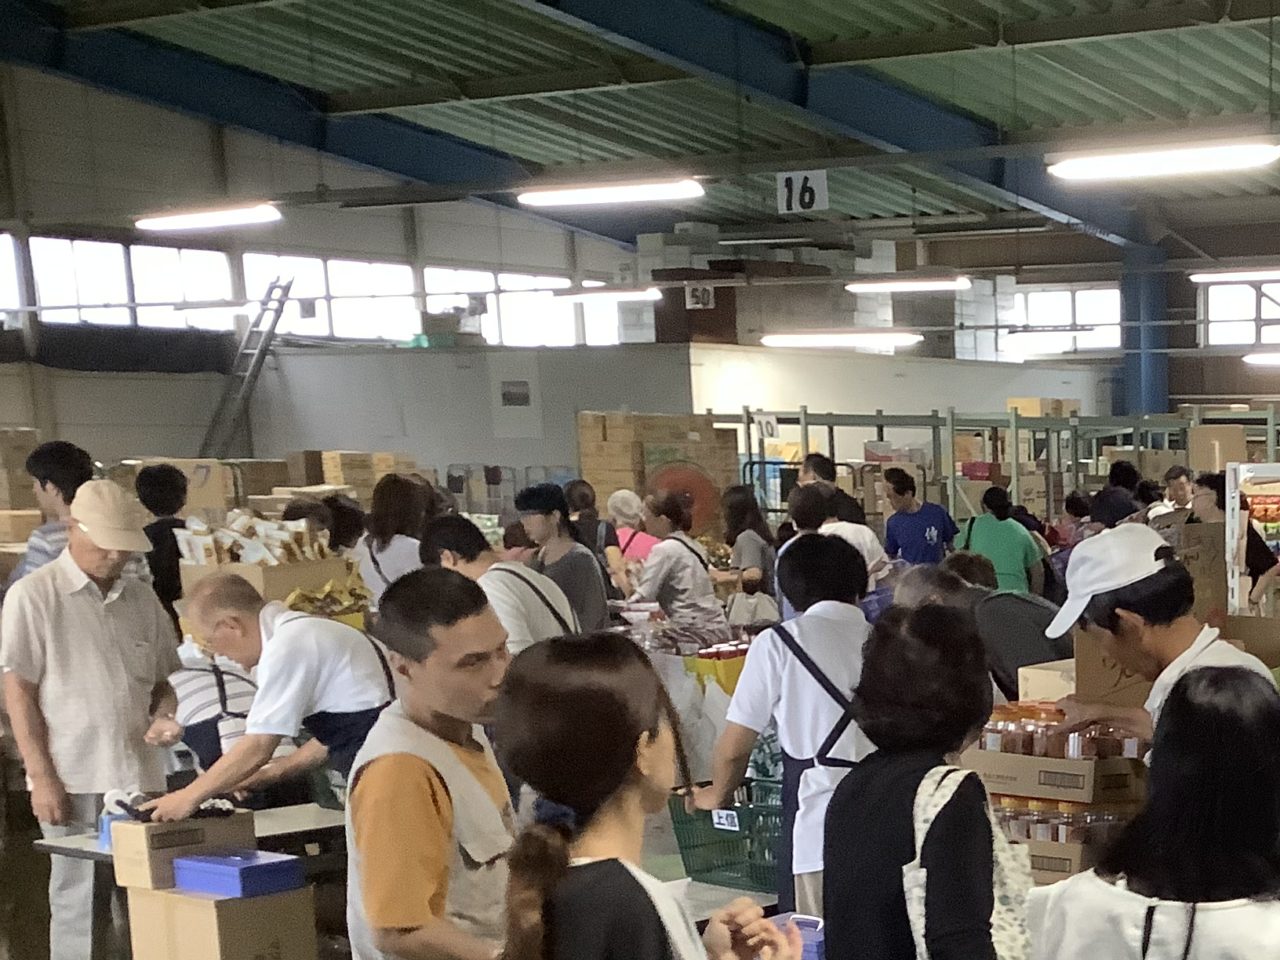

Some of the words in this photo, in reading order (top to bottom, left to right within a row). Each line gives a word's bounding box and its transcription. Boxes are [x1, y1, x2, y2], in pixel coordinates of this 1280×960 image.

[784, 175, 816, 211] 16
[691, 287, 711, 305] 50
[757, 420, 774, 438] 10
